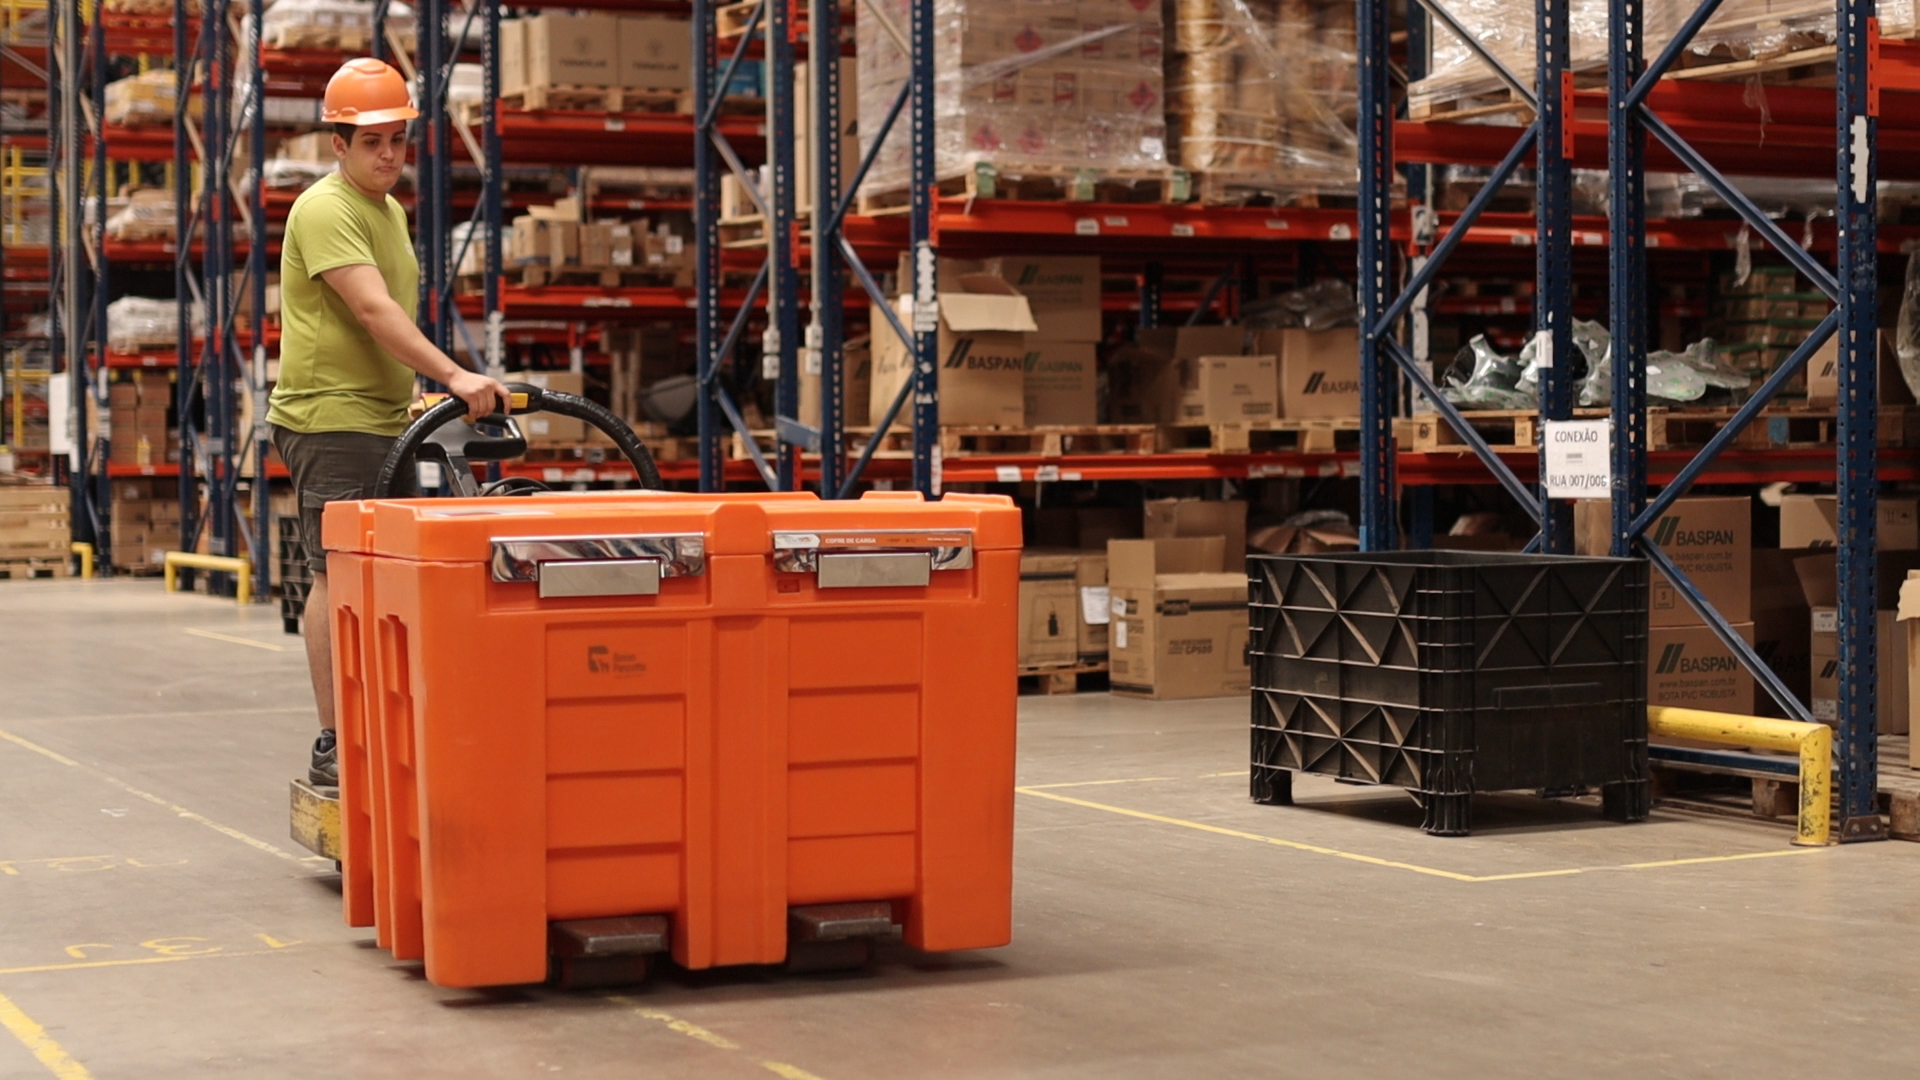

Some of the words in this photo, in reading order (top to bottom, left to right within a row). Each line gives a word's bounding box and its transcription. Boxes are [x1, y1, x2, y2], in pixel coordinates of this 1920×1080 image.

[967, 356, 1022, 370] BASPAN
[1321, 381, 1359, 394] BASPA
[1555, 428, 1598, 443] CONEXÃO
[1550, 475, 1567, 487] RUA
[1676, 530, 1734, 546] BASPAN
[1669, 552, 1733, 562] .baspan.com.br
[1680, 656, 1738, 673] BASPAN
[1772, 655, 1810, 672] BAS
[1659, 679, 1736, 688] www.baspan.com.br
[1658, 691, 1679, 702] BOTA
[1682, 691, 1697, 700] PVC
[1699, 689, 1736, 699] ROBUSTA
